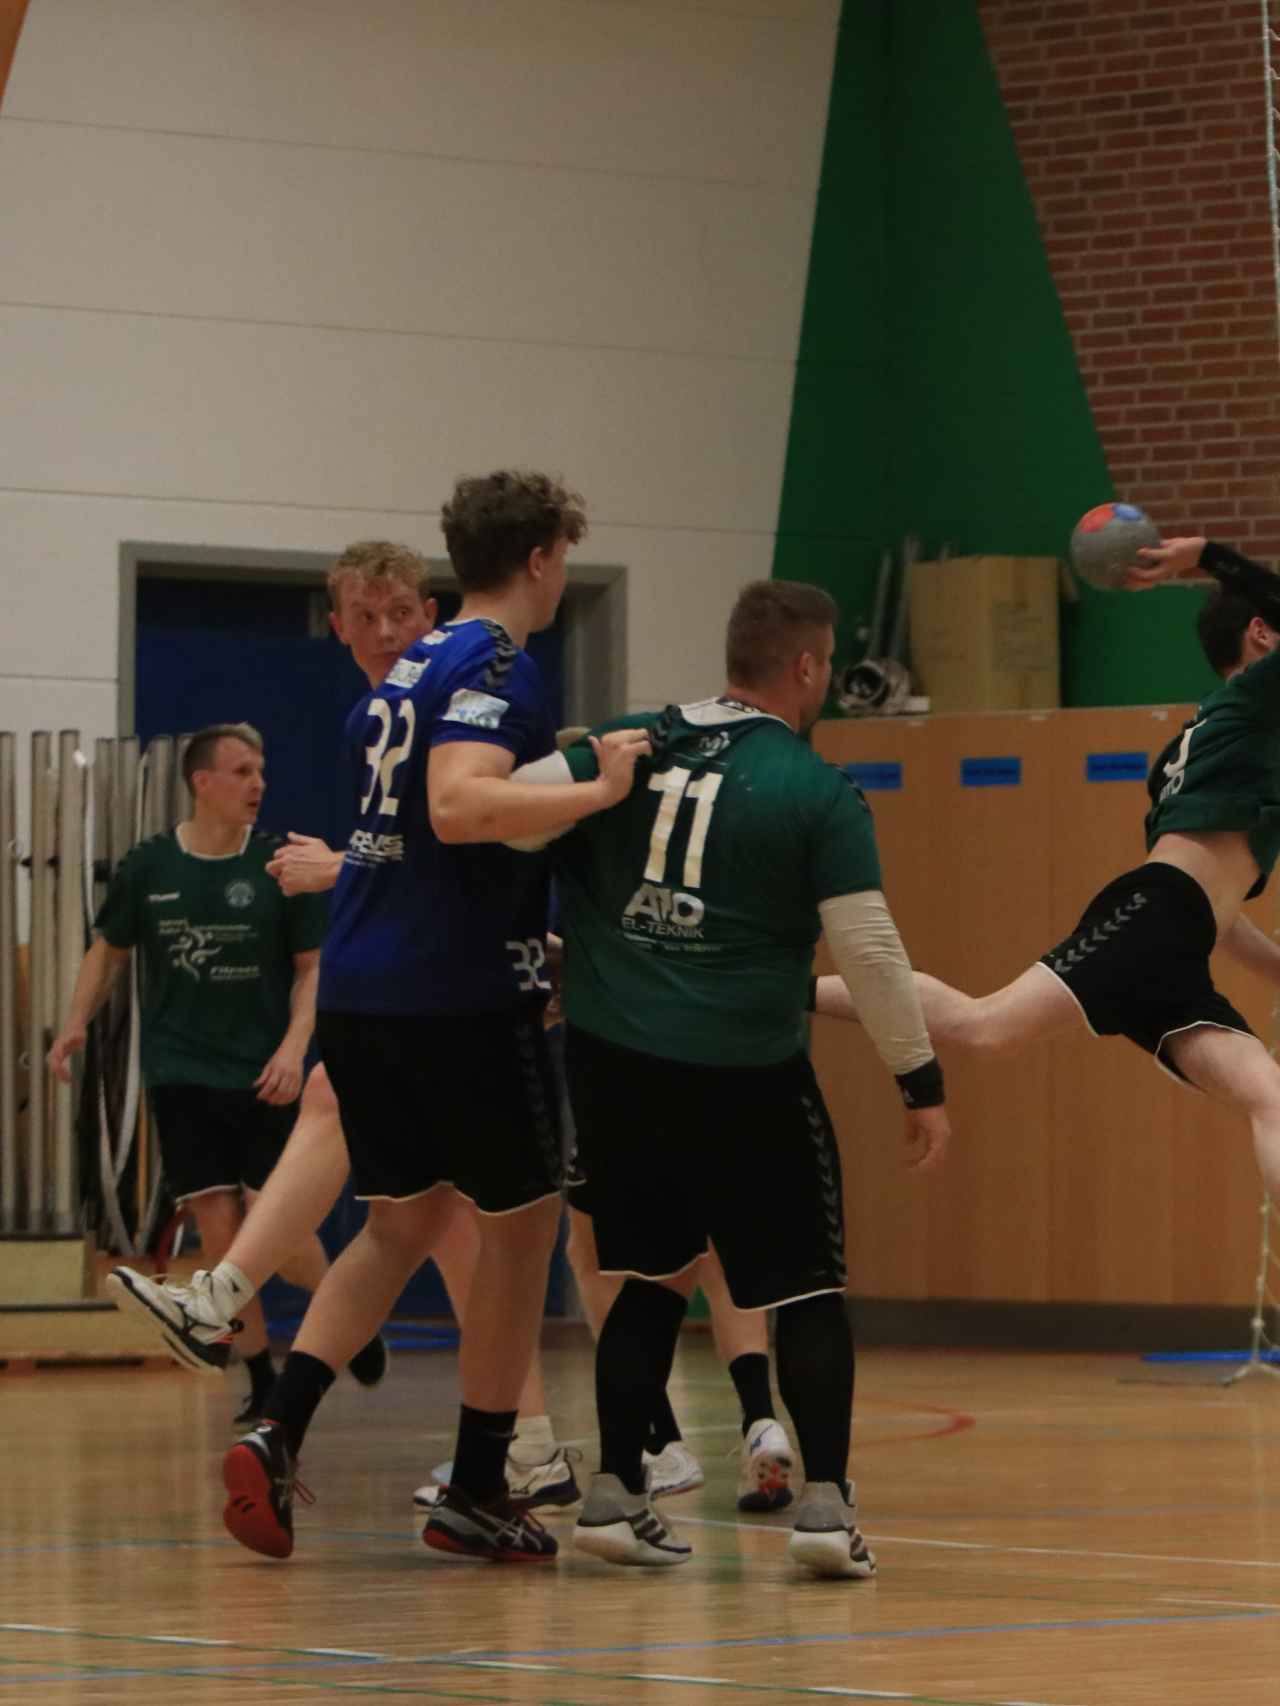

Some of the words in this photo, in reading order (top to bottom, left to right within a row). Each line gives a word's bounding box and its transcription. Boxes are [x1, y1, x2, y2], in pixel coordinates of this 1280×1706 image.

[361, 698, 416, 816] 32
[643, 765, 723, 889] 11
[505, 938, 552, 992] 32
